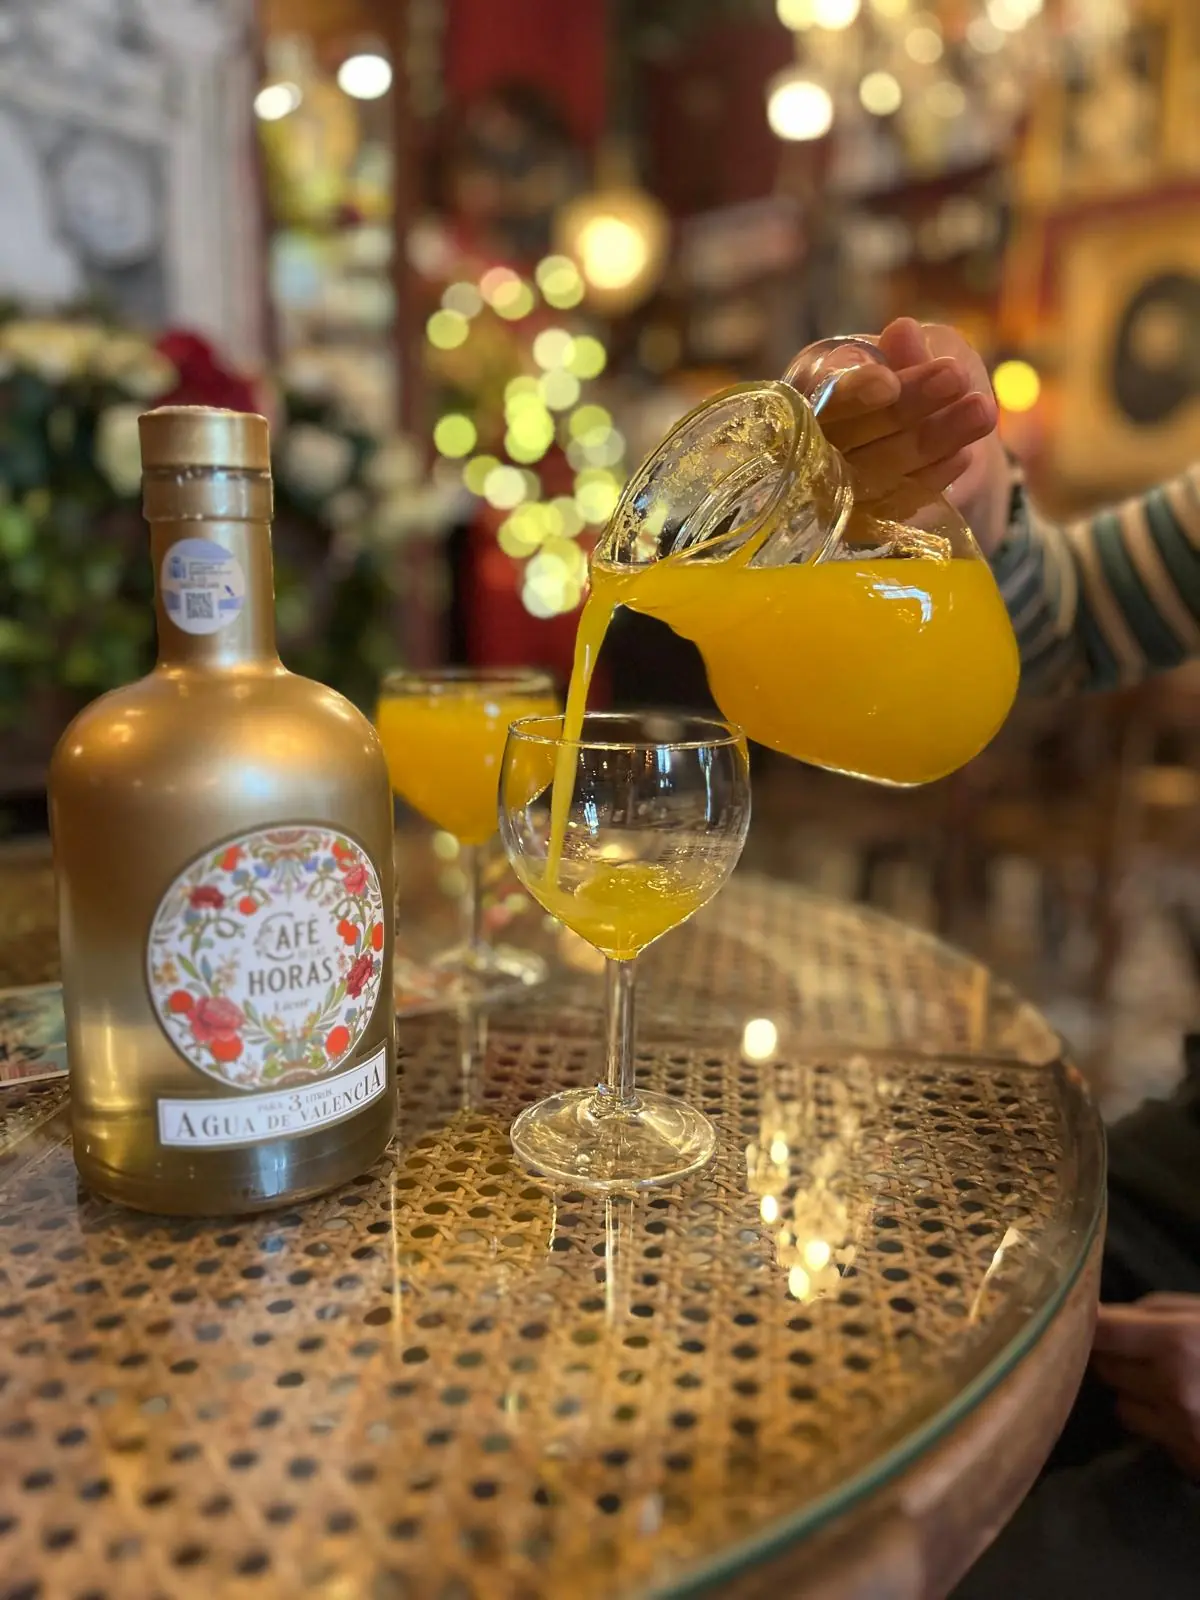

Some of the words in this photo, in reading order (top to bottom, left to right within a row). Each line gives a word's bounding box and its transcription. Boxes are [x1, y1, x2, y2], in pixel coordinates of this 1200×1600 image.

[253, 911, 320, 962] CAFÉ
[248, 956, 333, 996] HORAS
[176, 1111, 255, 1138] AGUA
[267, 1115, 290, 1130] DE
[300, 1064, 381, 1122] VALENCIA
[288, 1094, 302, 1112] 3
